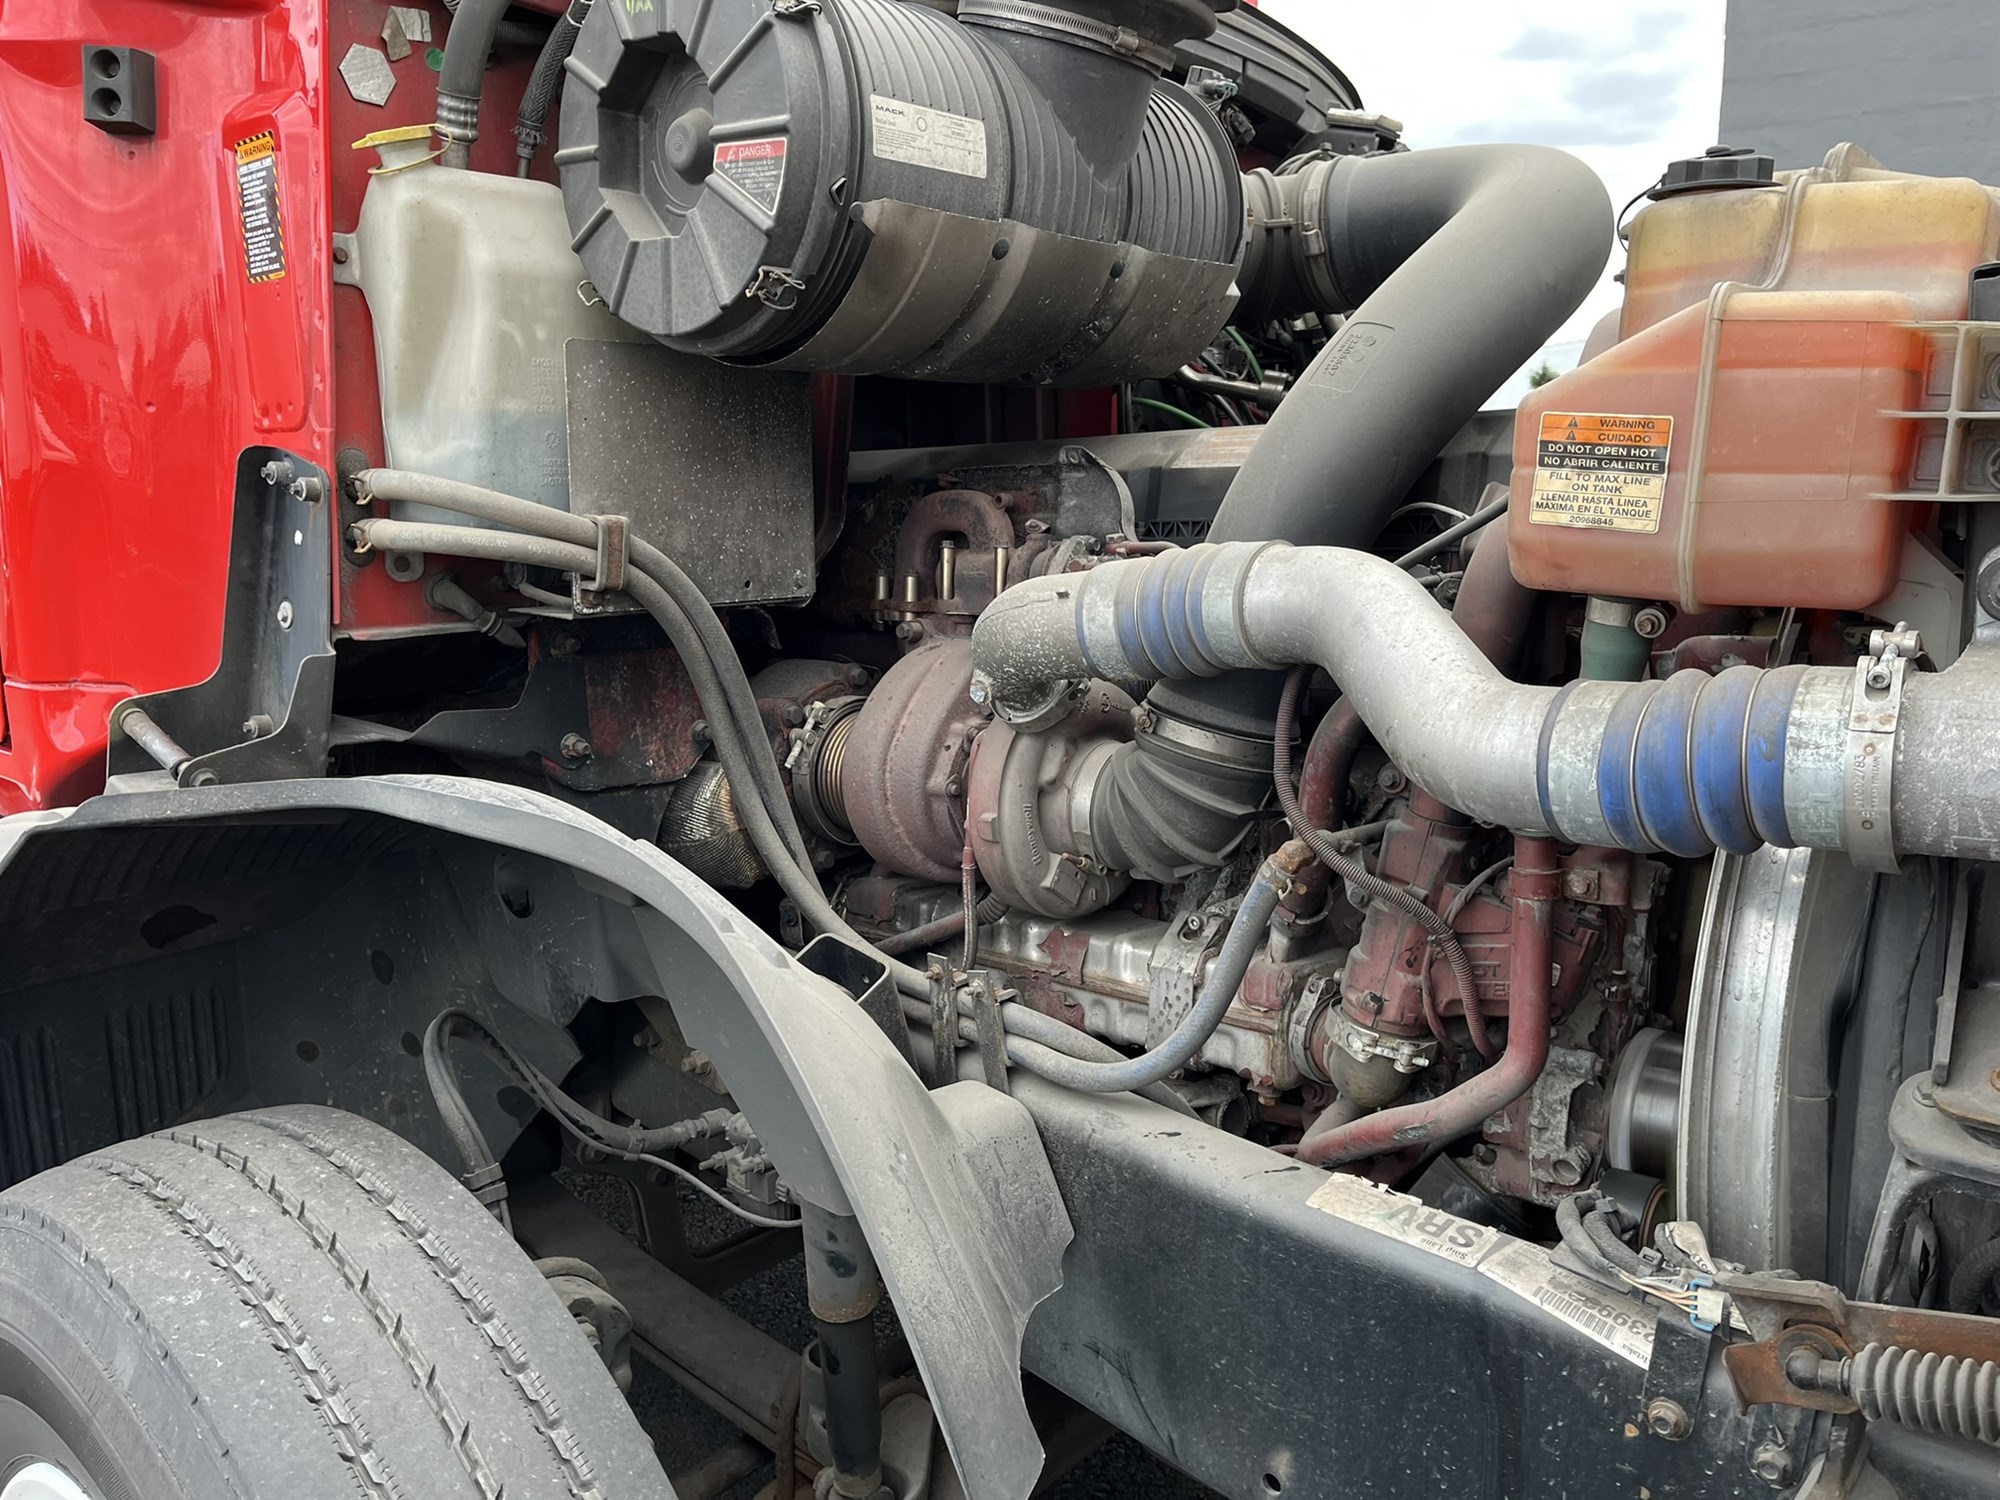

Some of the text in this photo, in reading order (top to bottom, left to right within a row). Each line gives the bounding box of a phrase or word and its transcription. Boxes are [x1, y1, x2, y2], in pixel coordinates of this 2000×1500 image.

[875, 104, 905, 117] MACK
[243, 141, 271, 158] WARNING
[739, 143, 771, 158] DANGER
[1600, 419, 1656, 430] WARNING
[1598, 432, 1652, 444] CUIDADO
[1548, 443, 1658, 458] DO NOT OPEN HOT
[1544, 456, 1660, 472] NO ABRIR CALIENTE
[1549, 472, 1651, 486] FILL TO MAX LINE
[1571, 483, 1623, 494] ON TANK
[1540, 493, 1648, 509] LLENAR HASTA LINEA
[1535, 501, 1652, 519] MAXIMA EN EL TANQUE
[1388, 1203, 1484, 1249] SRV
[1420, 1237, 1444, 1251] Lane
